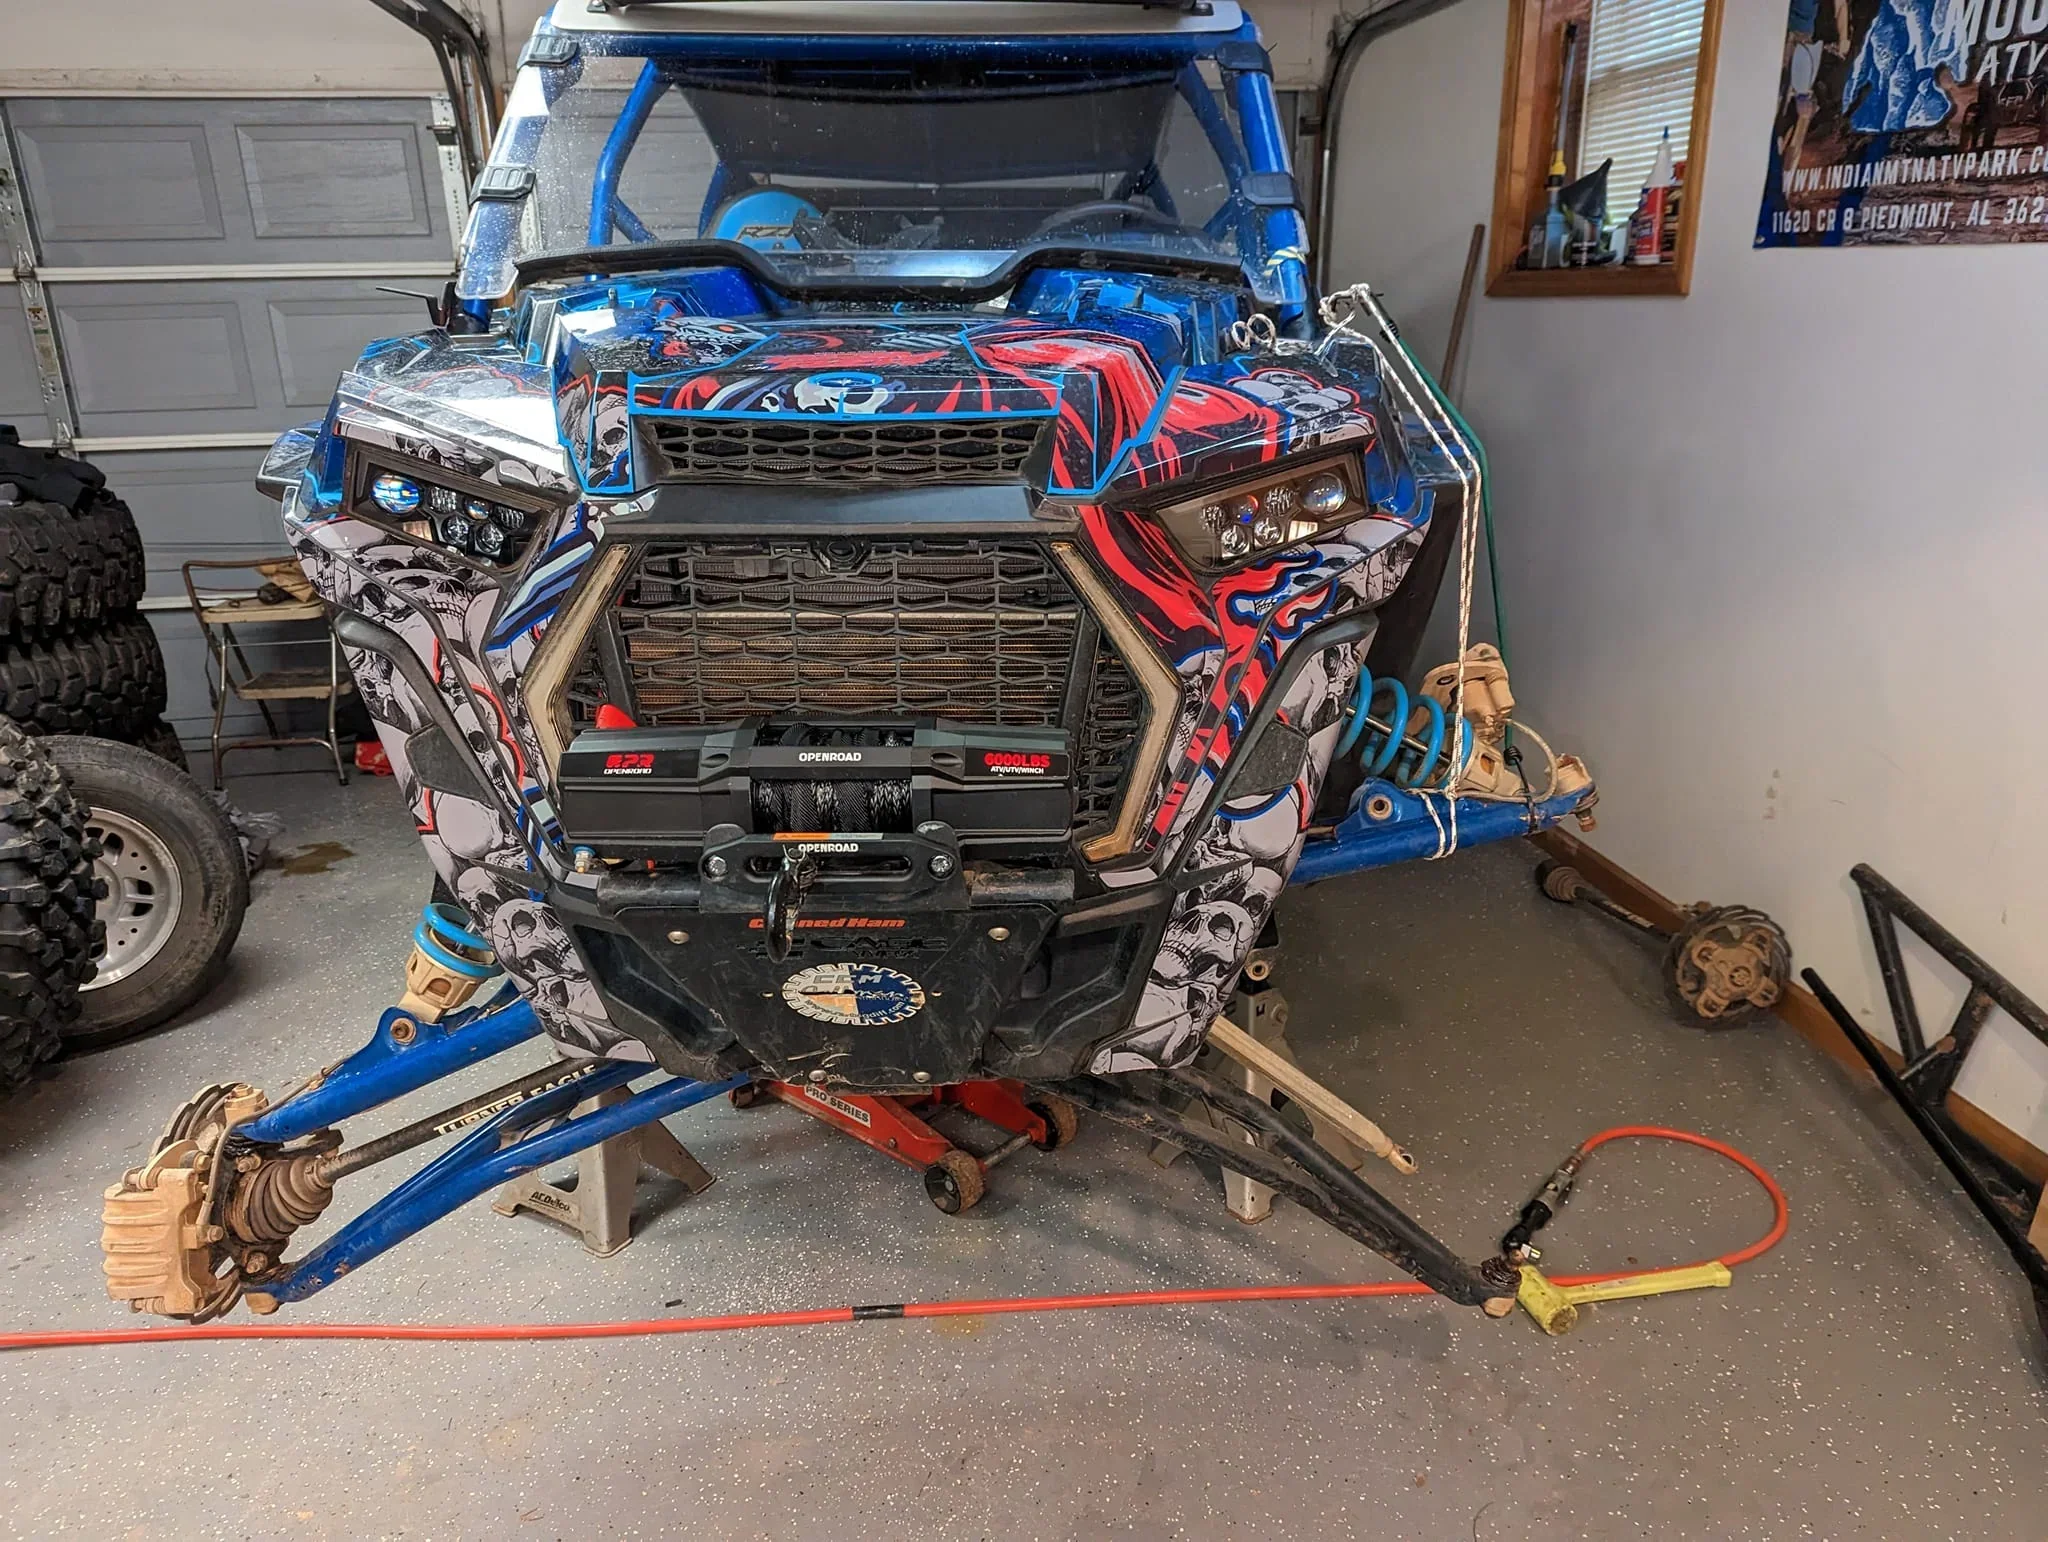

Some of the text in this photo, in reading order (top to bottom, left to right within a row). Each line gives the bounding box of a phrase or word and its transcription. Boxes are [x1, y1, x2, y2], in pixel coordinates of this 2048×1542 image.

[1772, 208, 1811, 234] 11620
[1816, 207, 1837, 232] CR
[1842, 207, 1855, 231] 8
[1861, 201, 1956, 232] PIEDMONT,
[1966, 199, 1992, 226] AL
[798, 752, 862, 762] OPENROAD
[984, 752, 1051, 768] 6000LBS
[798, 843, 859, 853] OPENROAD
[748, 917, 906, 929] Cned Ham
[805, 1085, 870, 1123] PRO SERIES
